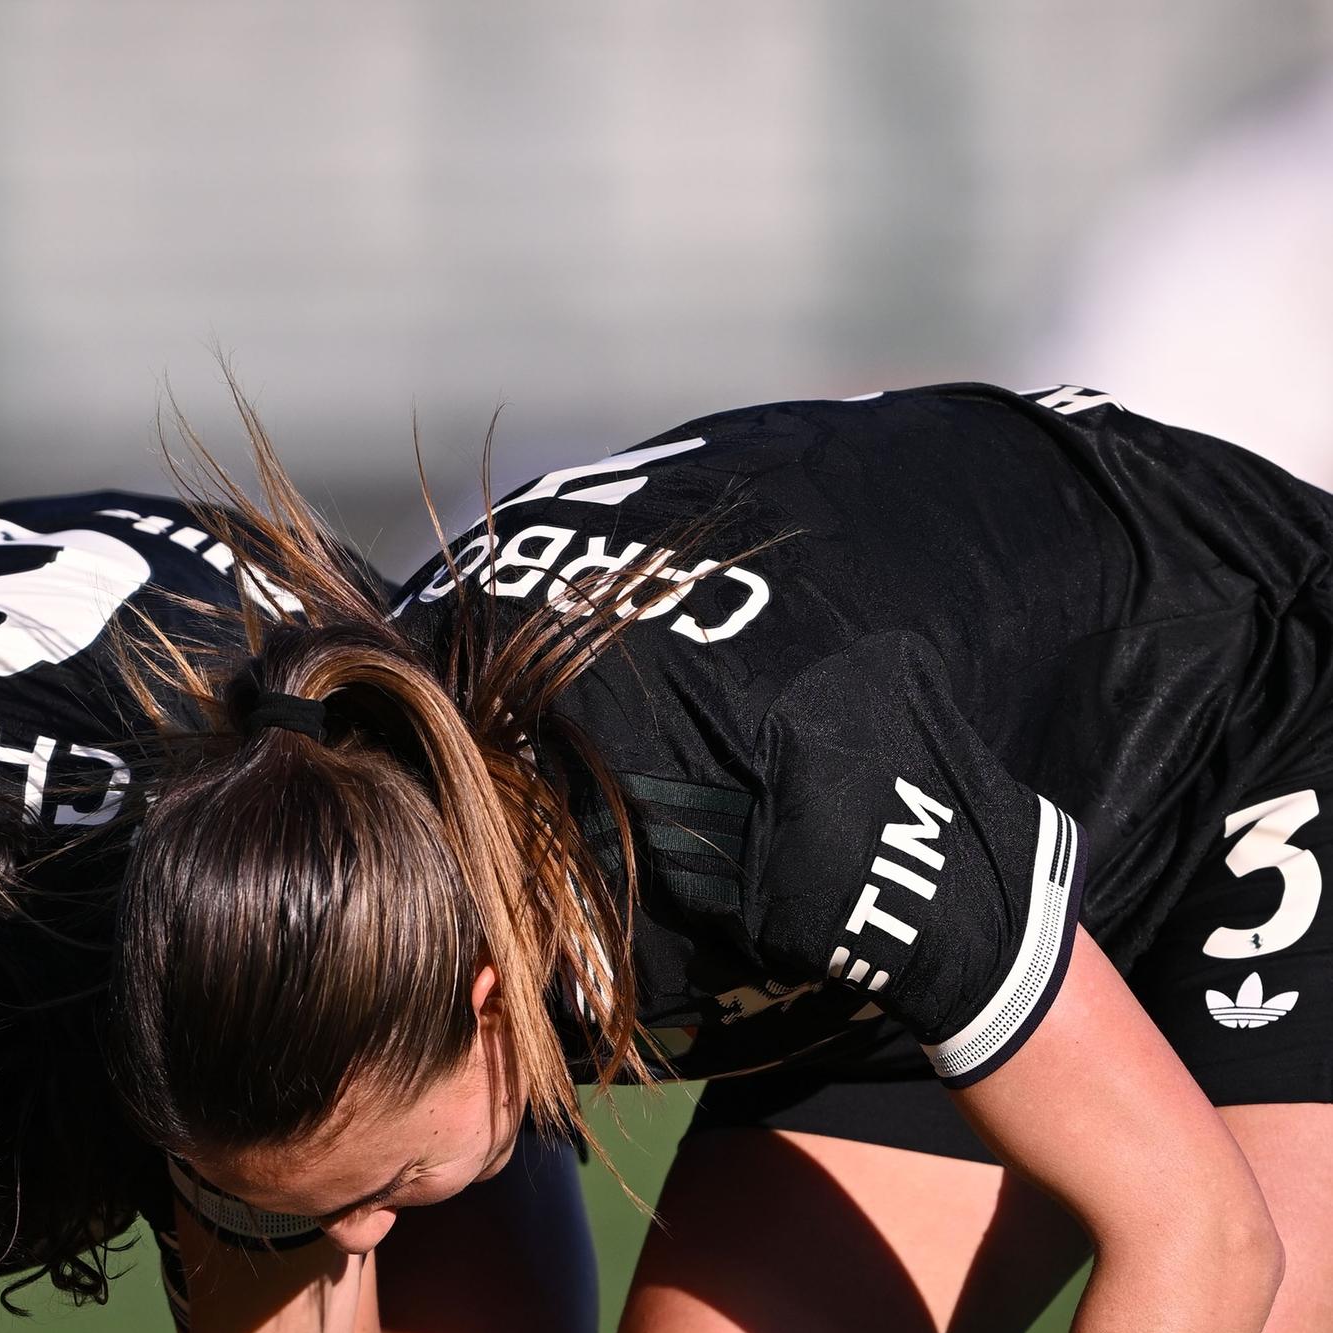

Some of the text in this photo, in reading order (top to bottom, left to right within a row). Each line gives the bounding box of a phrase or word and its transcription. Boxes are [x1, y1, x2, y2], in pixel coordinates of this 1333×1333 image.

[387, 524, 770, 643] CARBO
[844, 776, 954, 946] TIM
[1202, 789, 1322, 959] 3
